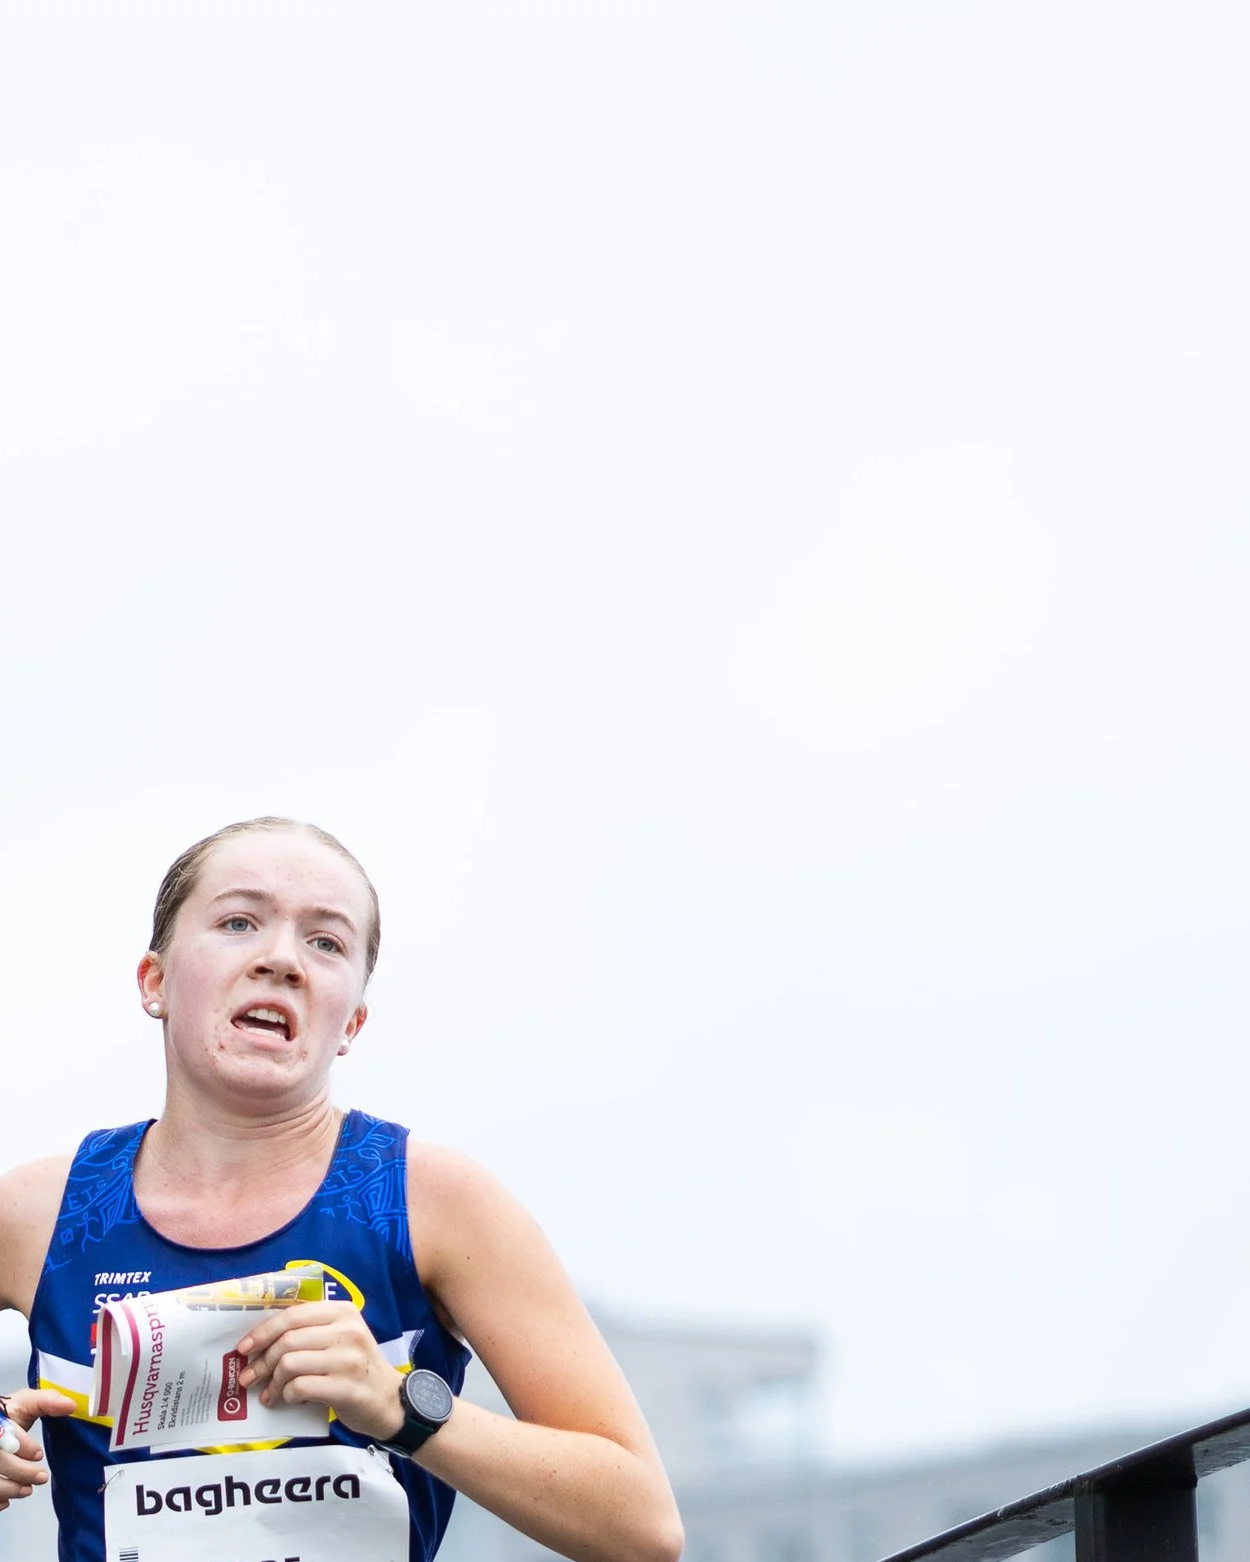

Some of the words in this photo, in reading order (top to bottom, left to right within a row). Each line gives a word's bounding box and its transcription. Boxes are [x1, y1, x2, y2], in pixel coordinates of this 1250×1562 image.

[93, 1271, 152, 1286] TRIMTEX
[226, 1356, 236, 1397] O-RINGEN
[157, 1409, 167, 1431] Skala
[168, 1385, 183, 1429] Ekvidistans
[135, 1473, 361, 1517] bagheera
